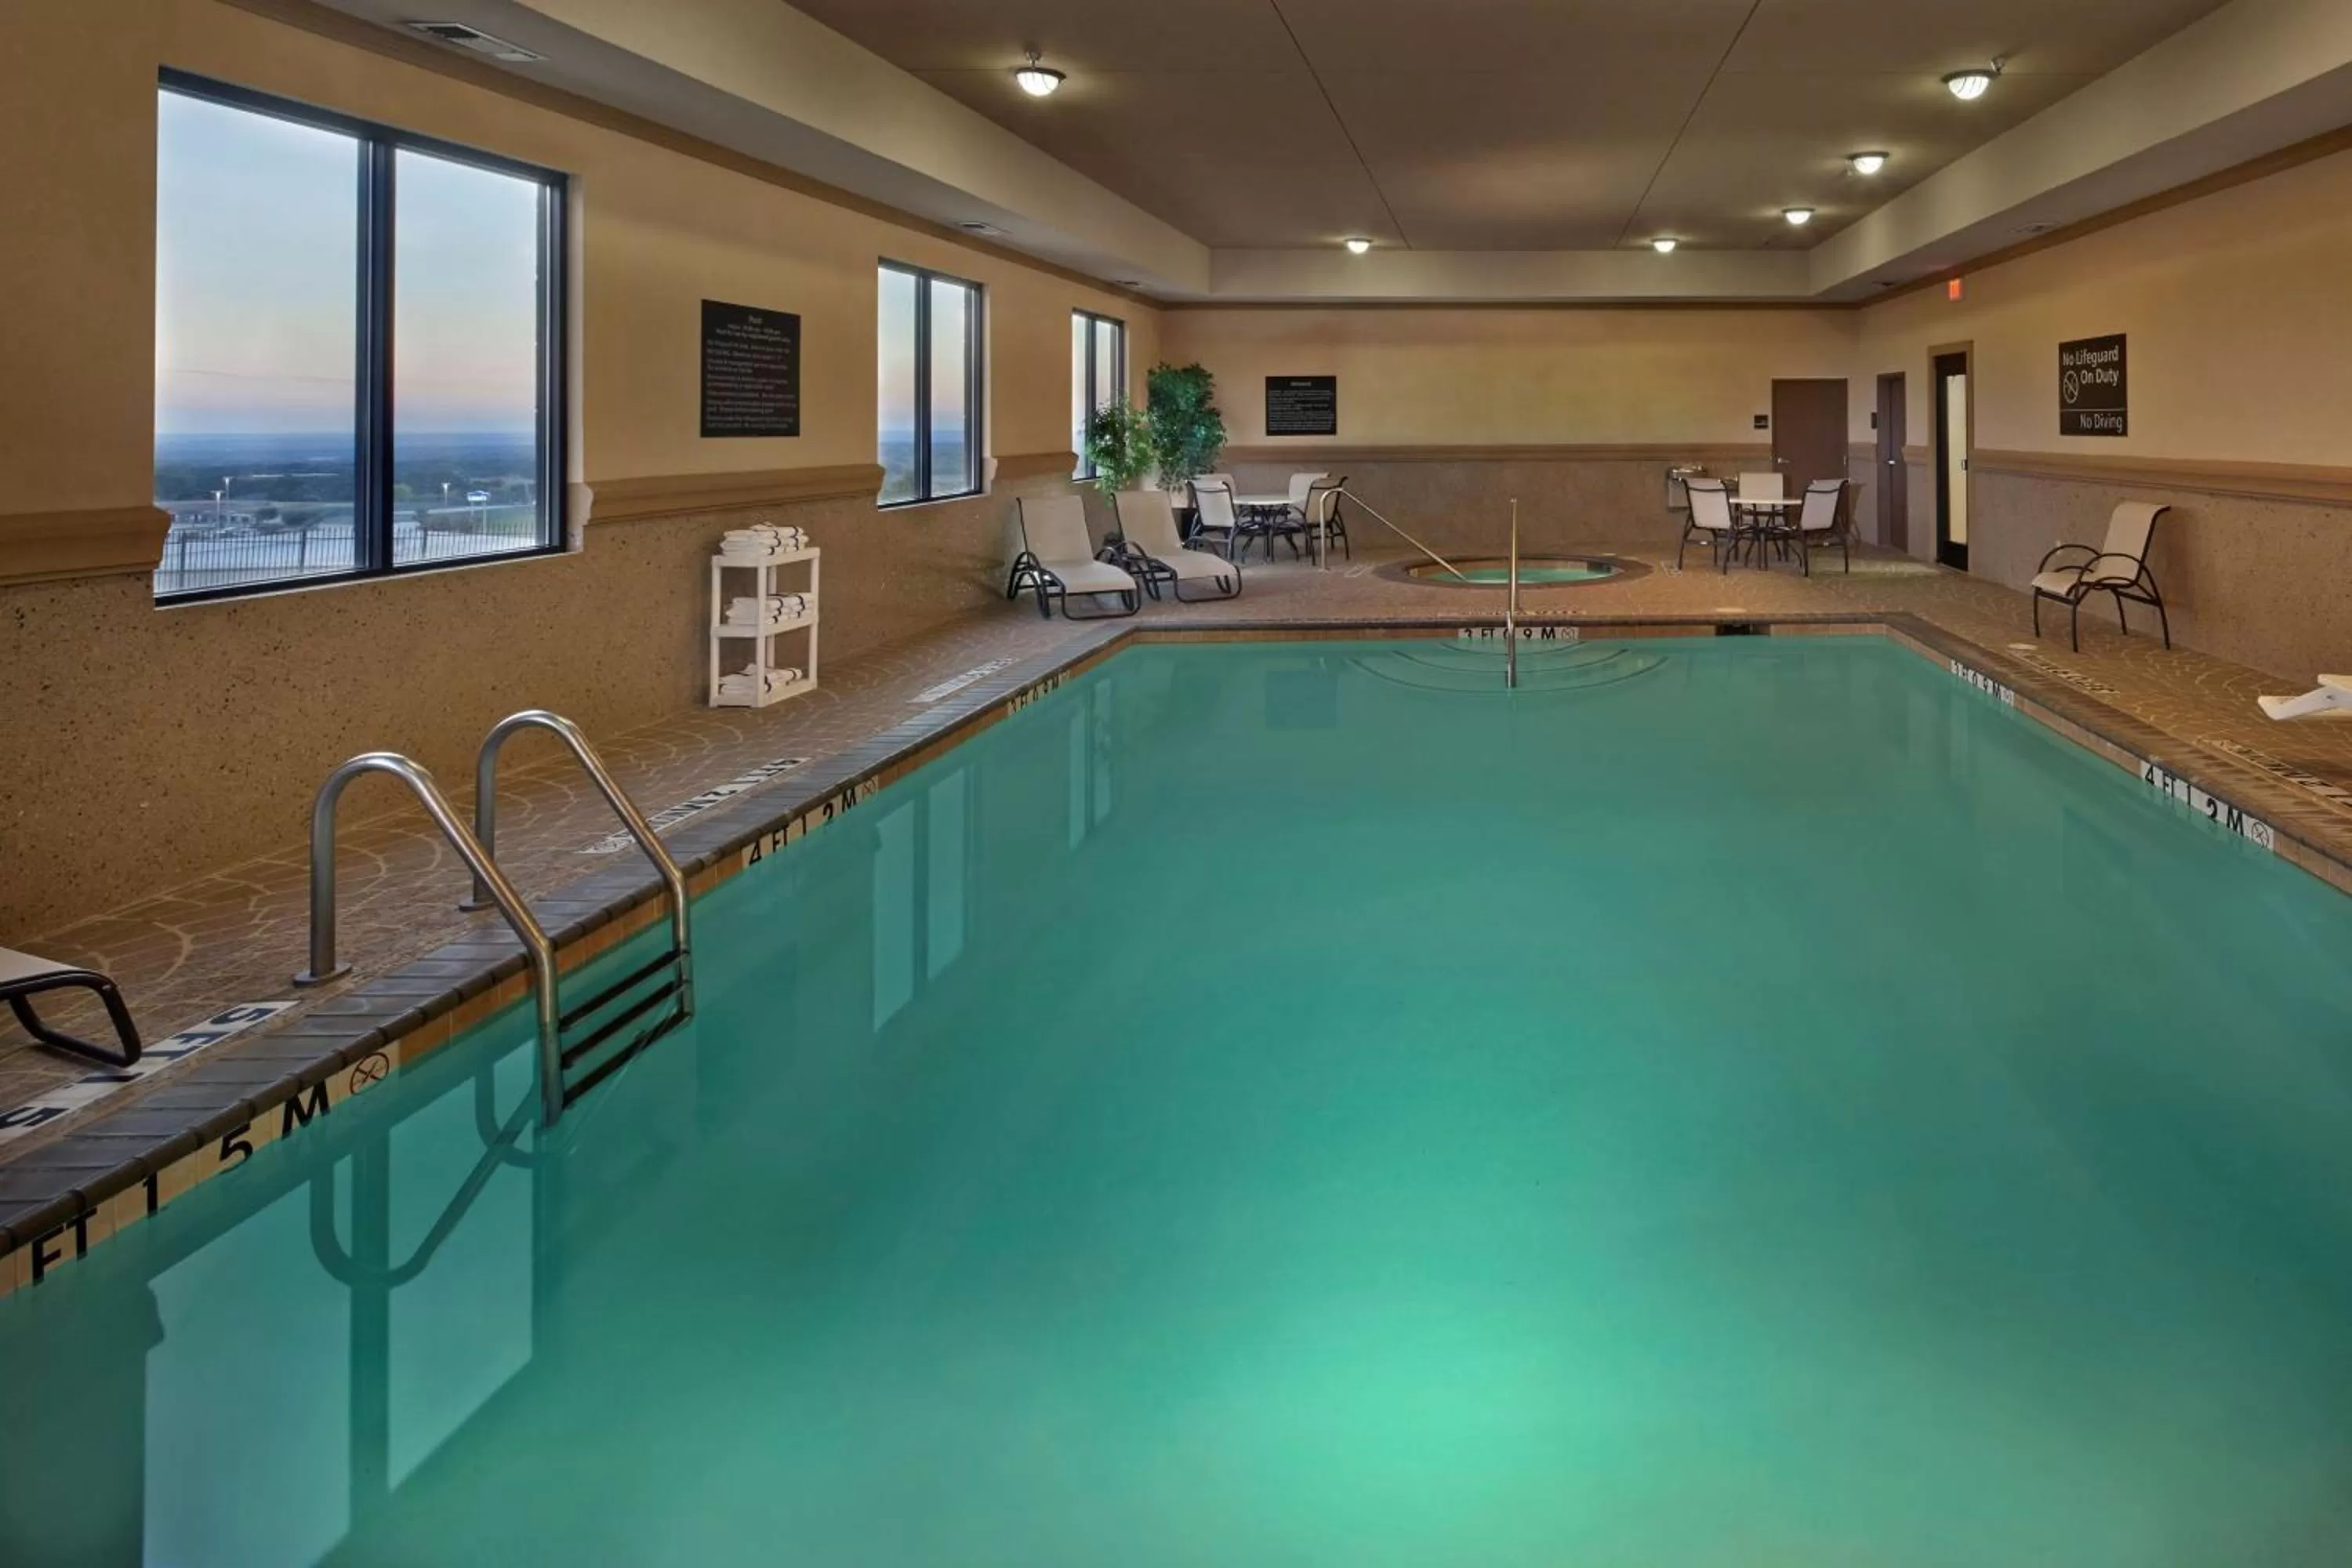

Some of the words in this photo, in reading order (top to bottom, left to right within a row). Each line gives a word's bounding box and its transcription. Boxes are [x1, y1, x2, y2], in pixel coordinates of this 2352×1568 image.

[2063, 350, 2074, 366] No
[2075, 345, 2119, 367] Lifeguard
[2080, 369, 2094, 384] On
[2096, 368, 2119, 387] Duty
[2080, 413, 2092, 429] No
[2094, 413, 2122, 434] Diving
[2144, 764, 2155, 786] 4
[2162, 773, 2176, 797] FT
[2226, 805, 2245, 837] M
[749, 838, 762, 866] 4
[772, 824, 790, 853] FT
[841, 786, 857, 813] M
[31, 1206, 98, 1287] FT
[219, 1122, 253, 1176] 5
[281, 1078, 331, 1141] M
